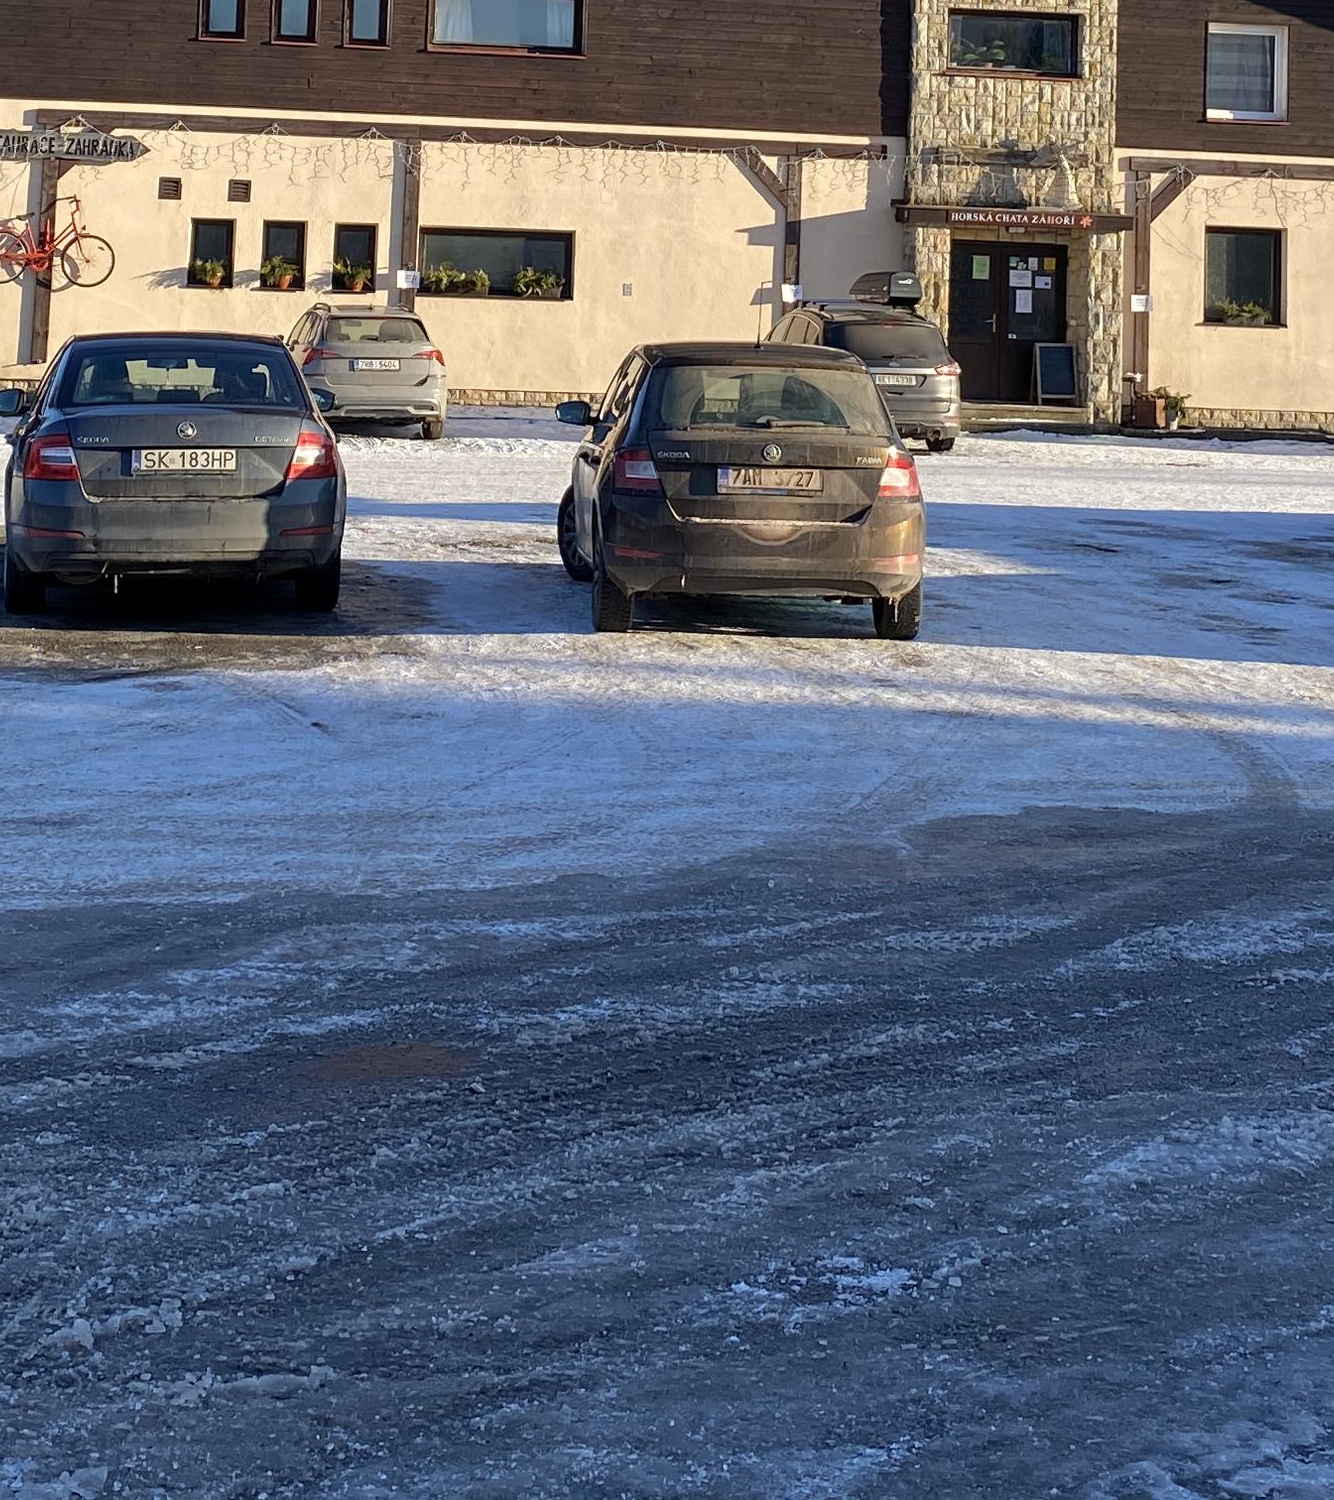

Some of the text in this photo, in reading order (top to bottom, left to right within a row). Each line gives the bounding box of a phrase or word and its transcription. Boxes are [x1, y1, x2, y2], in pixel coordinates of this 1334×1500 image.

[951, 212, 1075, 225] HORSKÁ CHATA ZÁHOŘÍ
[144, 451, 234, 468] SK 183HP
[657, 450, 691, 459] ŠKODA
